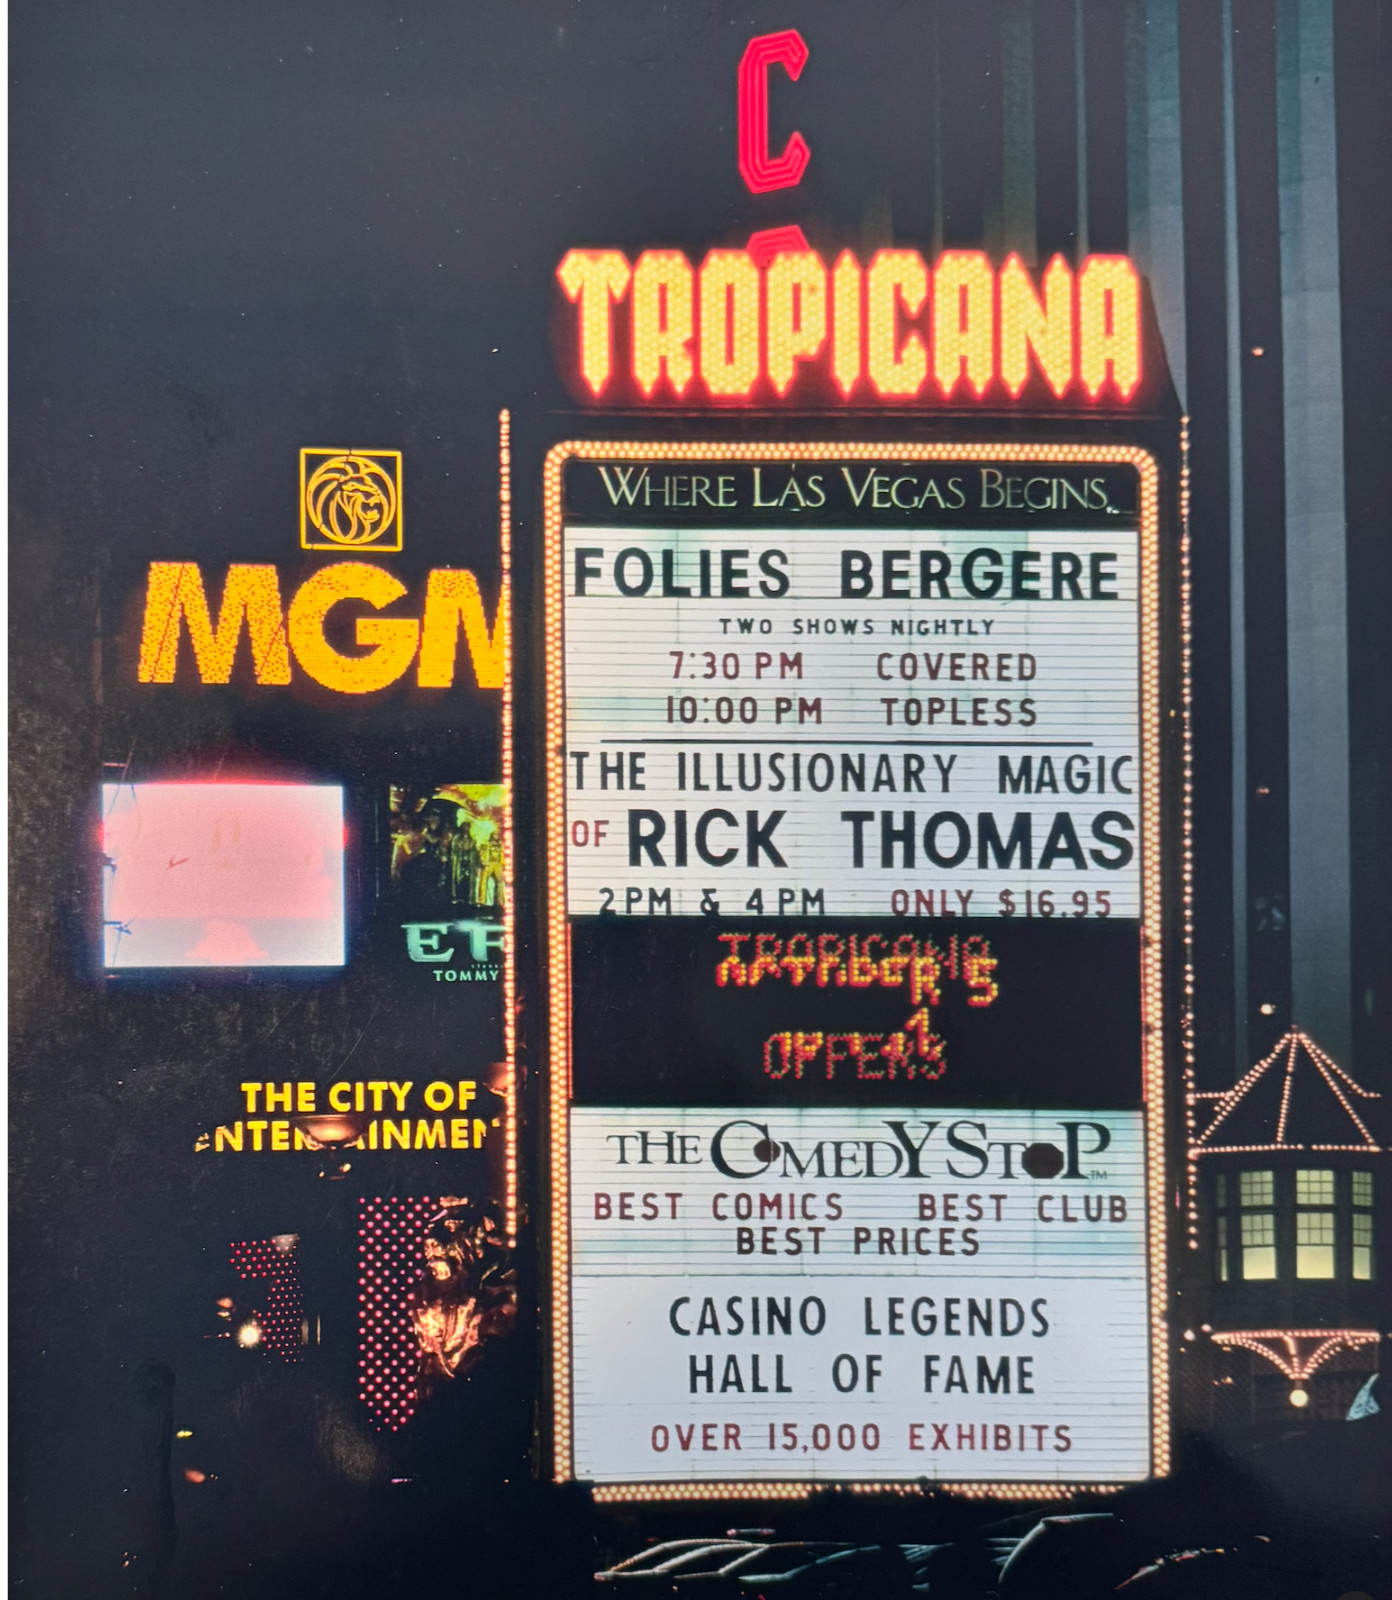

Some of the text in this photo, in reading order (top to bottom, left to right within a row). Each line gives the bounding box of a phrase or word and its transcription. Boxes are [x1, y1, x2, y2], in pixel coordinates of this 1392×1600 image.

[556, 248, 1143, 402] TROPICANA
[752, 466, 827, 508] LAS
[840, 466, 967, 510] VEGAS
[573, 547, 1120, 600] FOLIES BERGERE
[137, 560, 506, 694] MGM
[719, 618, 995, 637] TWO SHOWS NIGHTLY
[669, 651, 1037, 682] 7:30 PM COVERED
[666, 696, 1037, 726] 10:00 PM TOPLESS
[569, 751, 1133, 795] THE ILLUSIONARY MAGIC
[570, 808, 1134, 871] OF RICK THOMAS
[700, 887, 720, 916] &
[891, 888, 974, 918] ONLY
[998, 888, 1112, 919] $16.95
[433, 969, 499, 982] TOMMY
[241, 1081, 477, 1113] THE CITY OF
[606, 1130, 703, 1166] THE
[595, 1194, 1128, 1222] BEST COMICS BEST CLUB
[737, 1228, 980, 1256] BEST PRICES
[669, 1297, 1050, 1337] CASINO LEGENDS
[689, 1354, 1035, 1395] HALL OF FAME
[651, 1423, 1072, 1454] OVER 15,000 EXHIBITS
